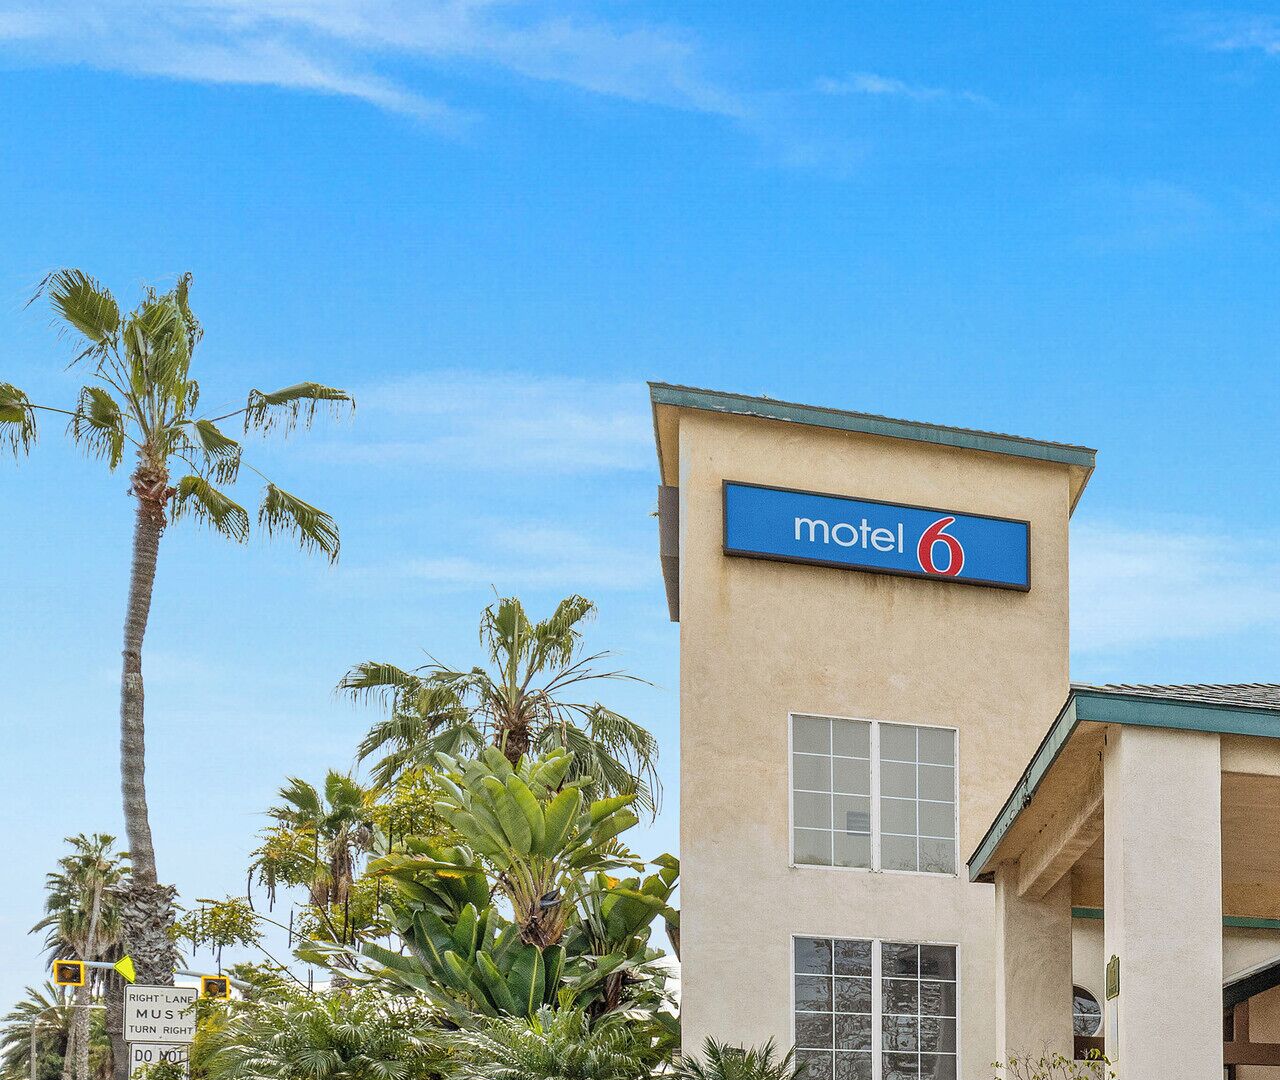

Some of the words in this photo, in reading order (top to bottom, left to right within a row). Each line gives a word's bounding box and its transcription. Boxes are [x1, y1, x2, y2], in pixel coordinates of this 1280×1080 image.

[795, 516, 904, 554] motel
[916, 516, 966, 577] 6
[129, 994, 159, 1003] RIGHT
[165, 995, 194, 1004] LANE
[136, 1009, 188, 1020] MUST
[129, 1025, 157, 1034] TURN
[163, 1026, 194, 1035] RIGHT
[134, 1049, 153, 1062] DO
[159, 1050, 184, 1063] NOT
